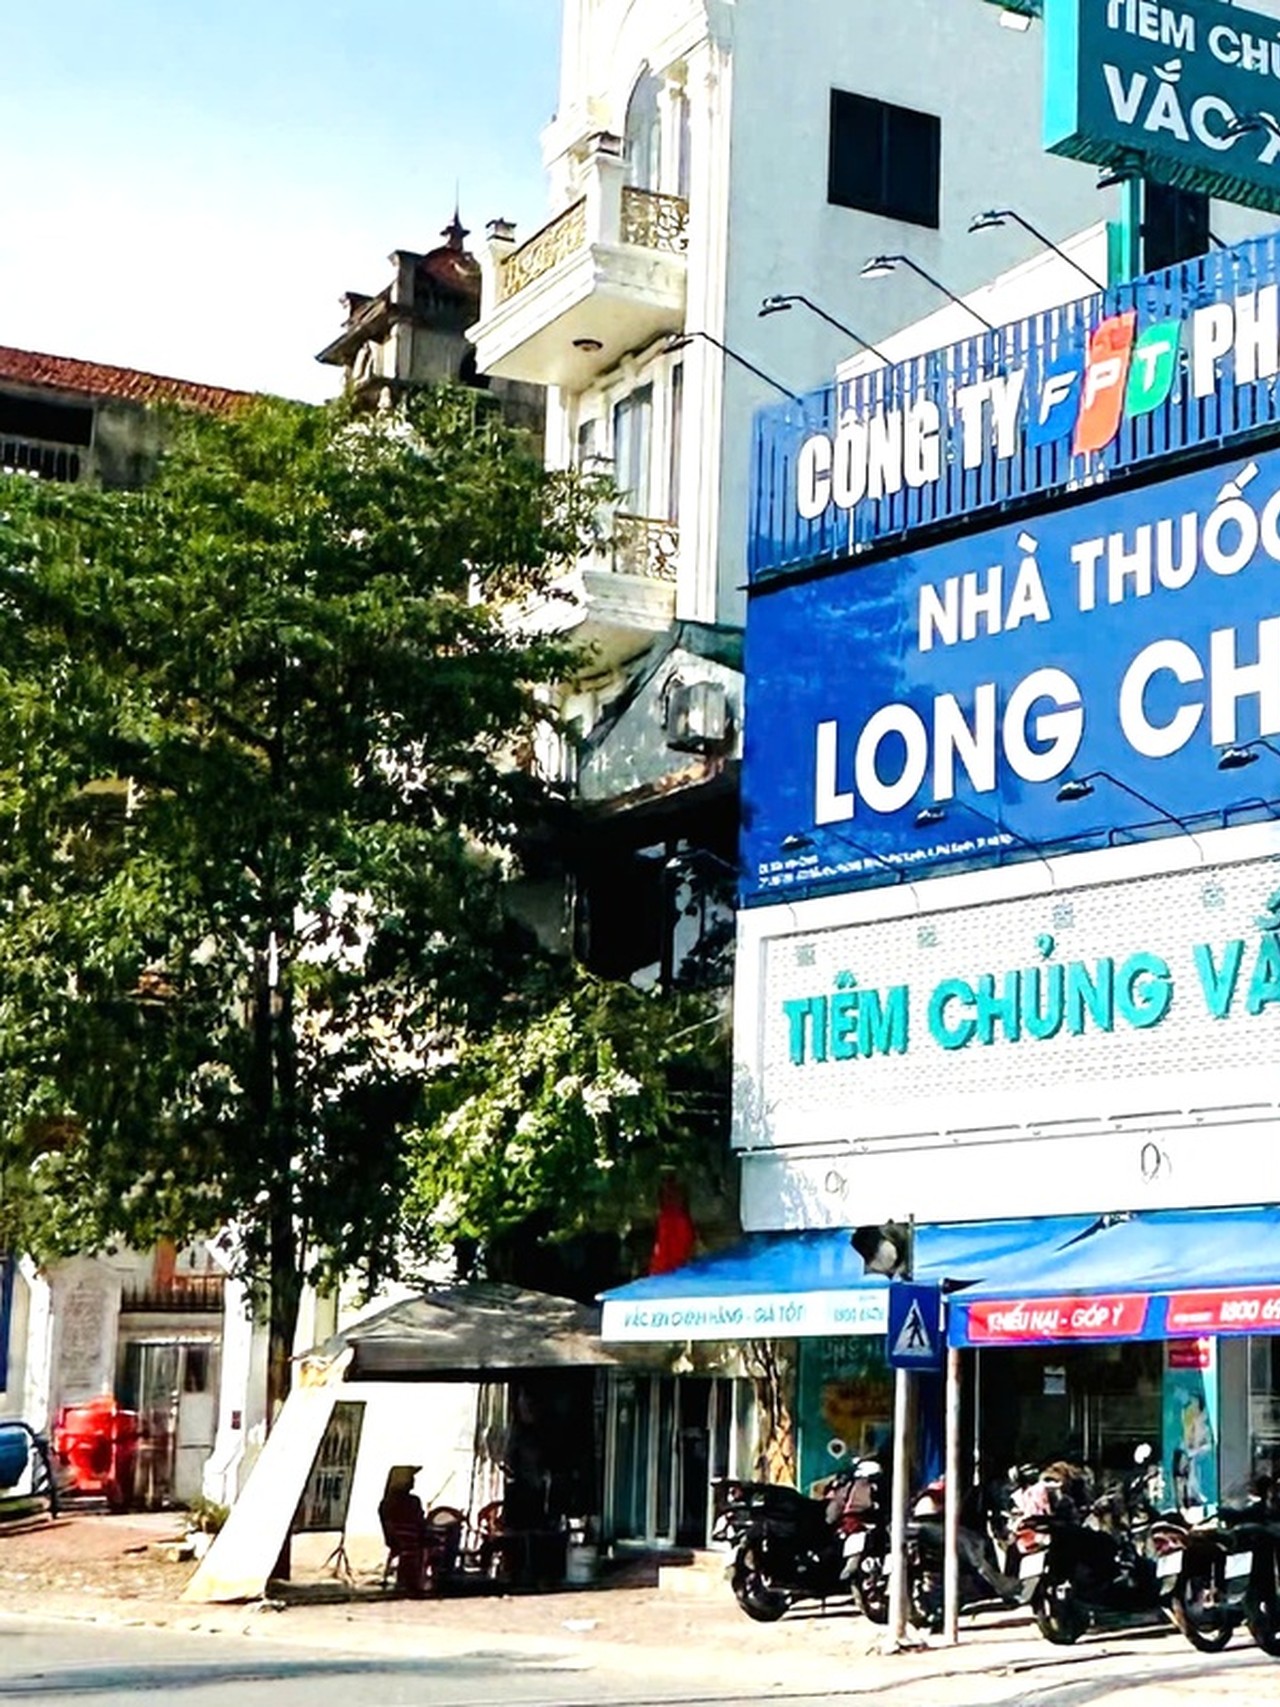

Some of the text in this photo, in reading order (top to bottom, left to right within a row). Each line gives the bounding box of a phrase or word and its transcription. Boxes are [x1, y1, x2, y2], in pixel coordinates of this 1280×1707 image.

[1102, 58, 1241, 150] VẮC
[797, 399, 940, 521] CÔNG
[956, 371, 1024, 469] TY
[1035, 336, 1174, 430] FPT
[918, 532, 1054, 652] NHÀ
[814, 666, 1084, 825] LONG
[782, 970, 910, 1066] TIÊM
[927, 932, 1174, 1050] CHỦNG
[1071, 1303, 1109, 1328] GÓP
[1220, 1299, 1260, 1322] 1800
